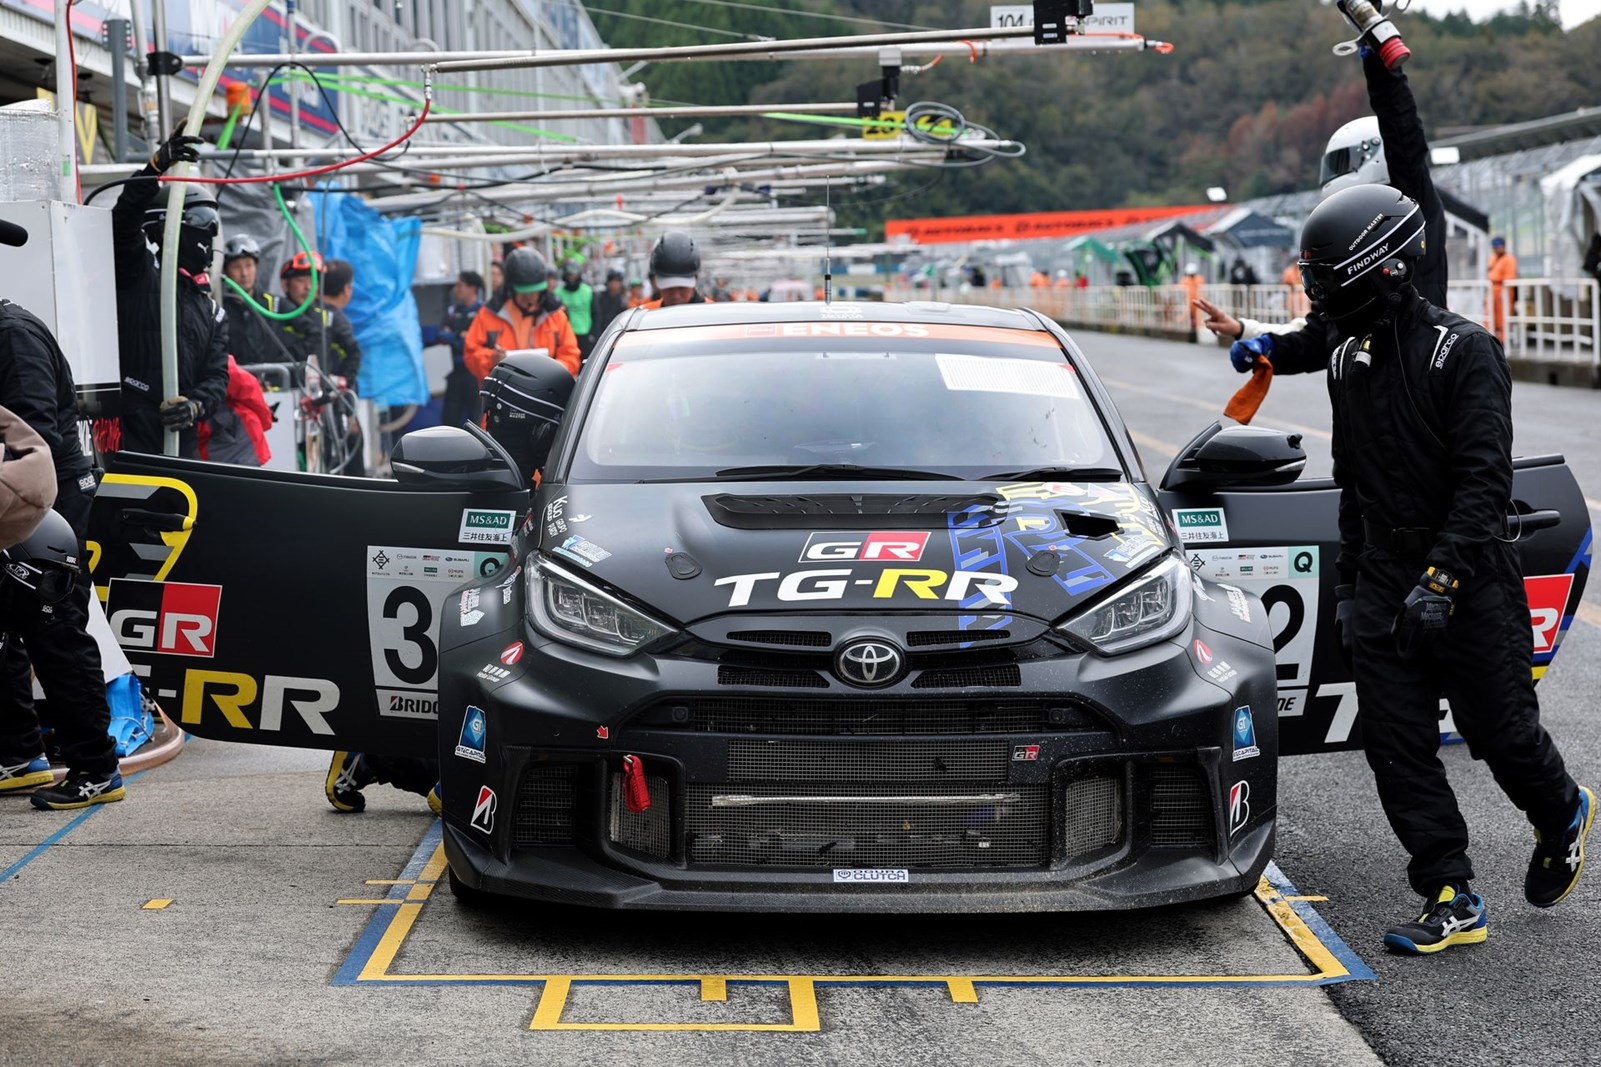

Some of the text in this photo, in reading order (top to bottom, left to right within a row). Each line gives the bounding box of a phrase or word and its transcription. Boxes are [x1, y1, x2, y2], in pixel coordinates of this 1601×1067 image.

[1348, 229, 1368, 251] OUTDOOR
[1346, 242, 1390, 275] FINDWAY
[783, 323, 930, 338] ENEOS
[470, 514, 507, 526] MS&AD
[1181, 514, 1219, 524] MS&AD
[463, 532, 507, 542] 三井住友海上
[1181, 530, 1224, 541] 三井住友海上
[806, 541, 921, 560] GR
[1294, 551, 1313, 573] Q
[713, 568, 1019, 607] TG-RR
[109, 609, 213, 652] GR
[383, 585, 438, 684] 3
[1261, 584, 1305, 681] 2
[1013, 751, 1038, 760] GR
[853, 873, 906, 881] CLUTCH
